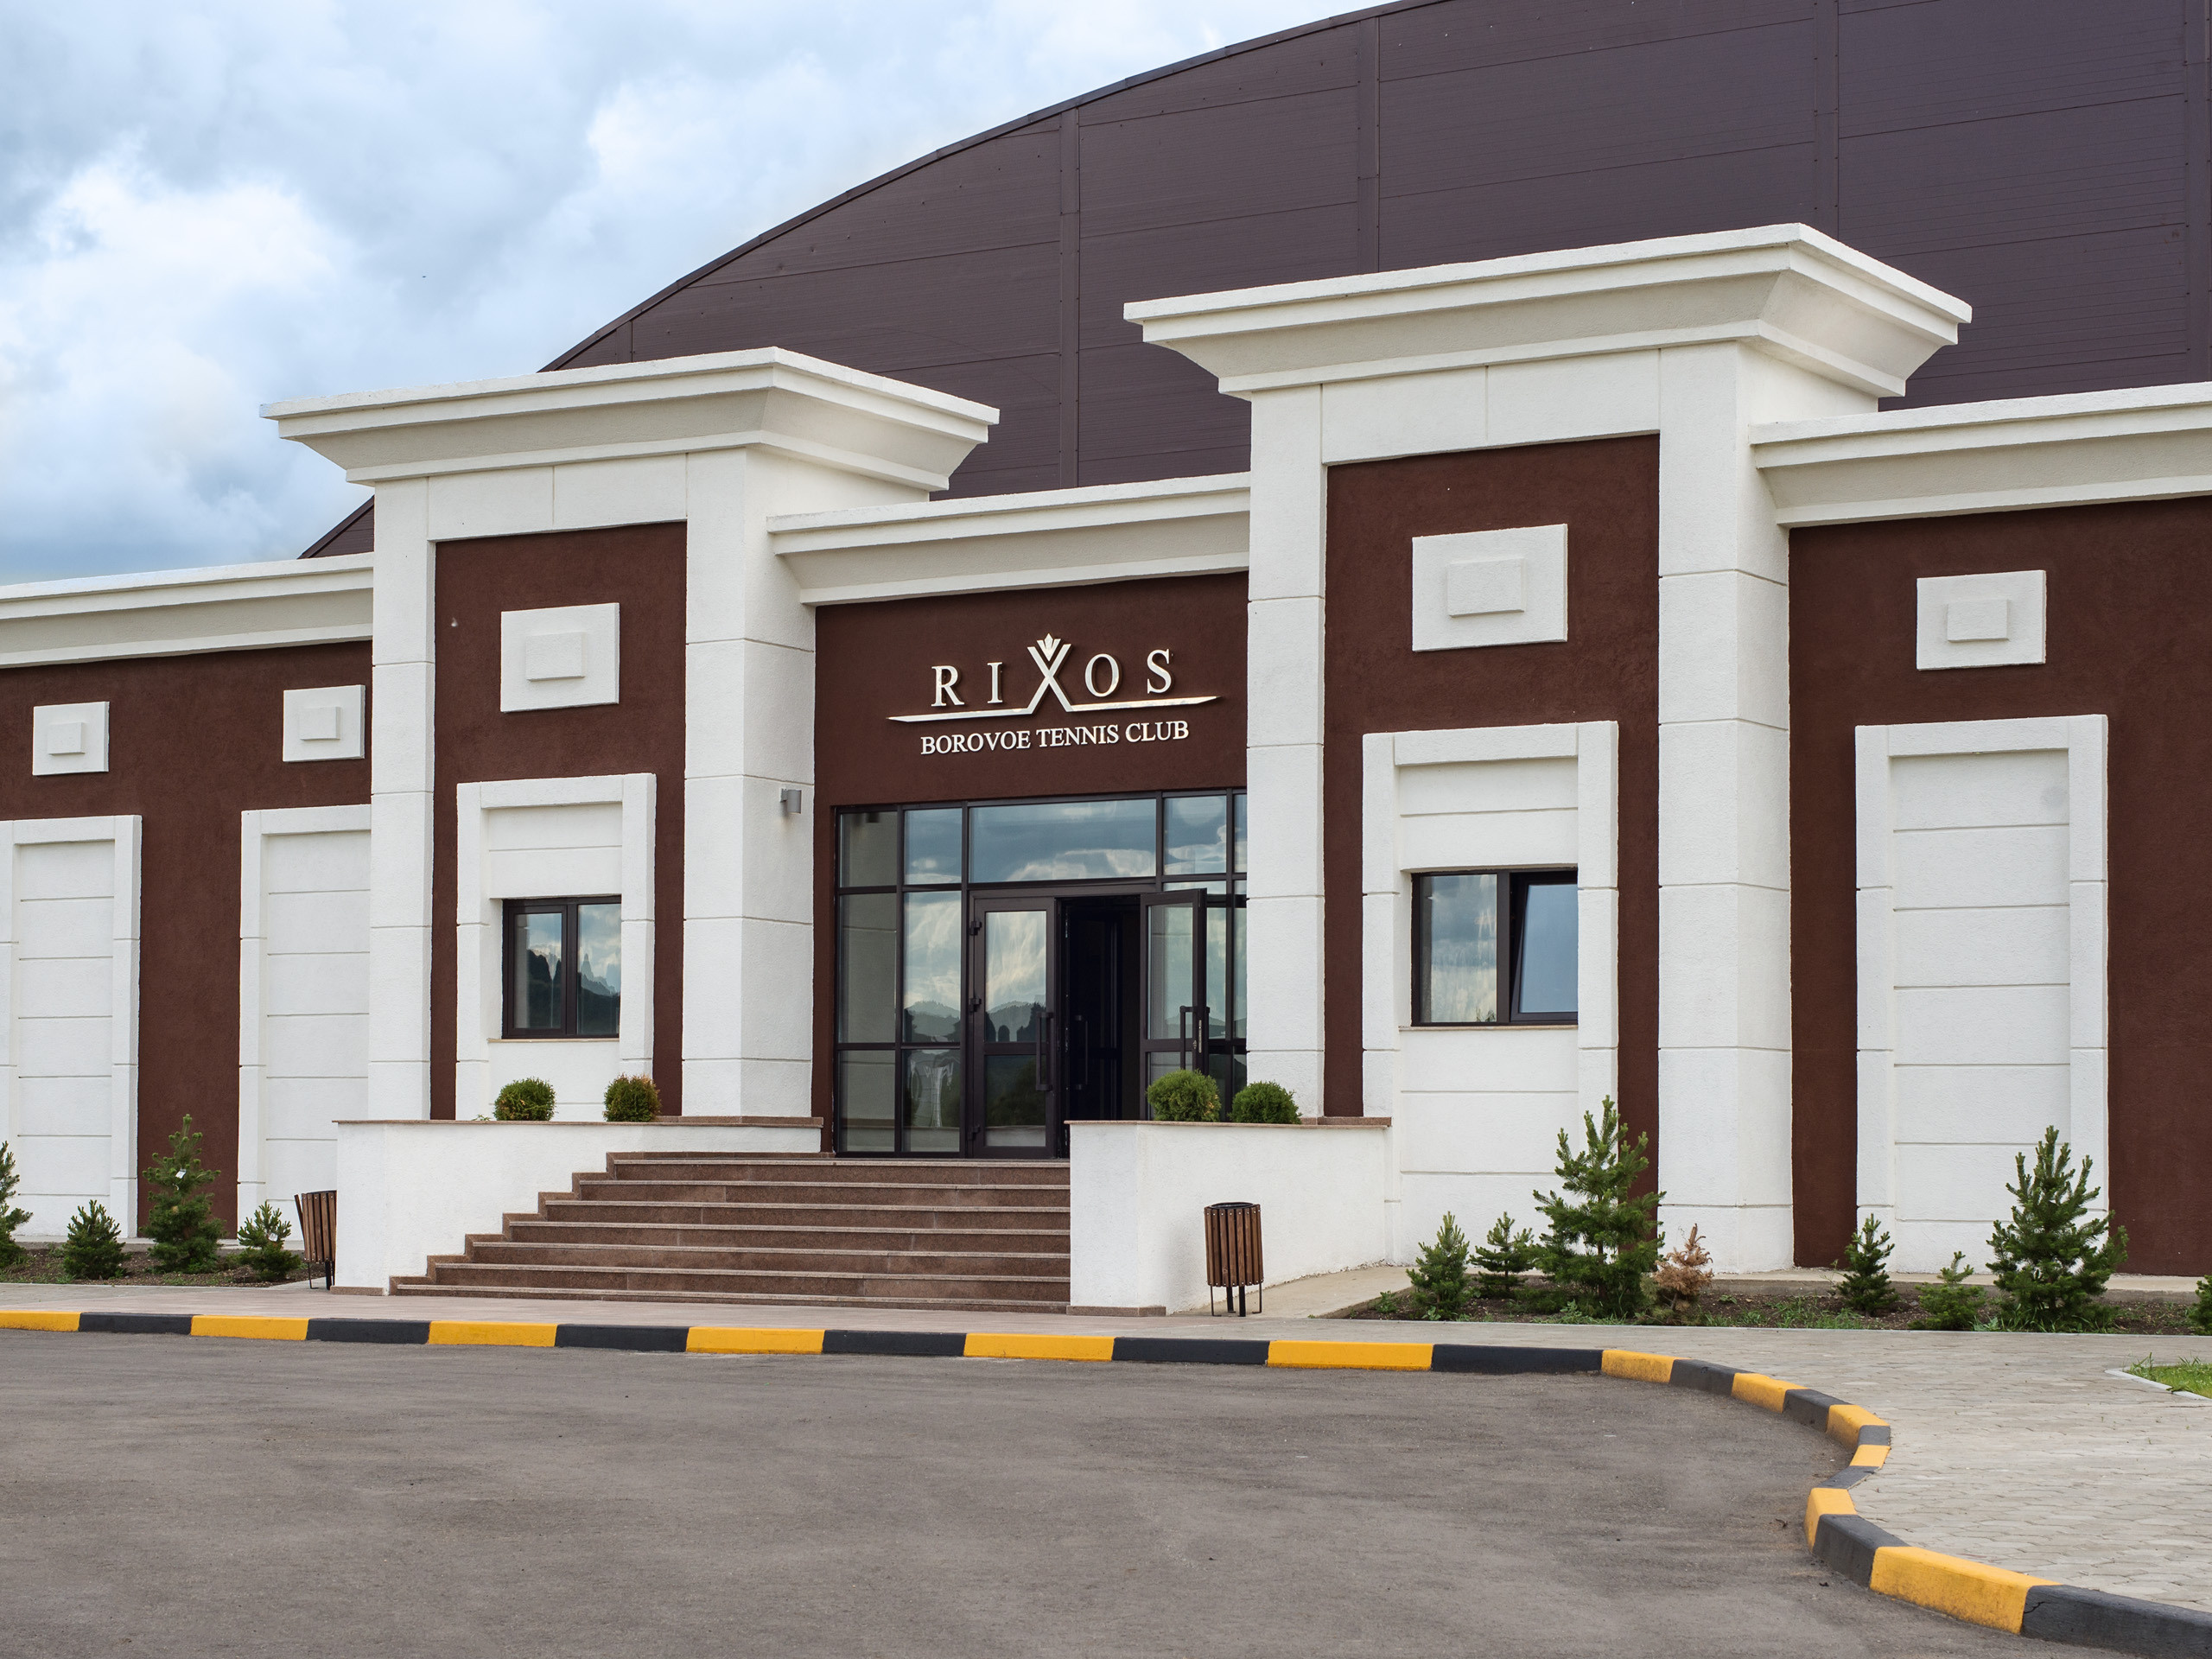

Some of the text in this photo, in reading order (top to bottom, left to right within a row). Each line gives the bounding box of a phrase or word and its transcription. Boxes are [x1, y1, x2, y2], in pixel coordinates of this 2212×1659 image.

[930, 639, 1173, 713] RIXOS
[920, 720, 1189, 755] BOROVOE TENNIS CLUB
